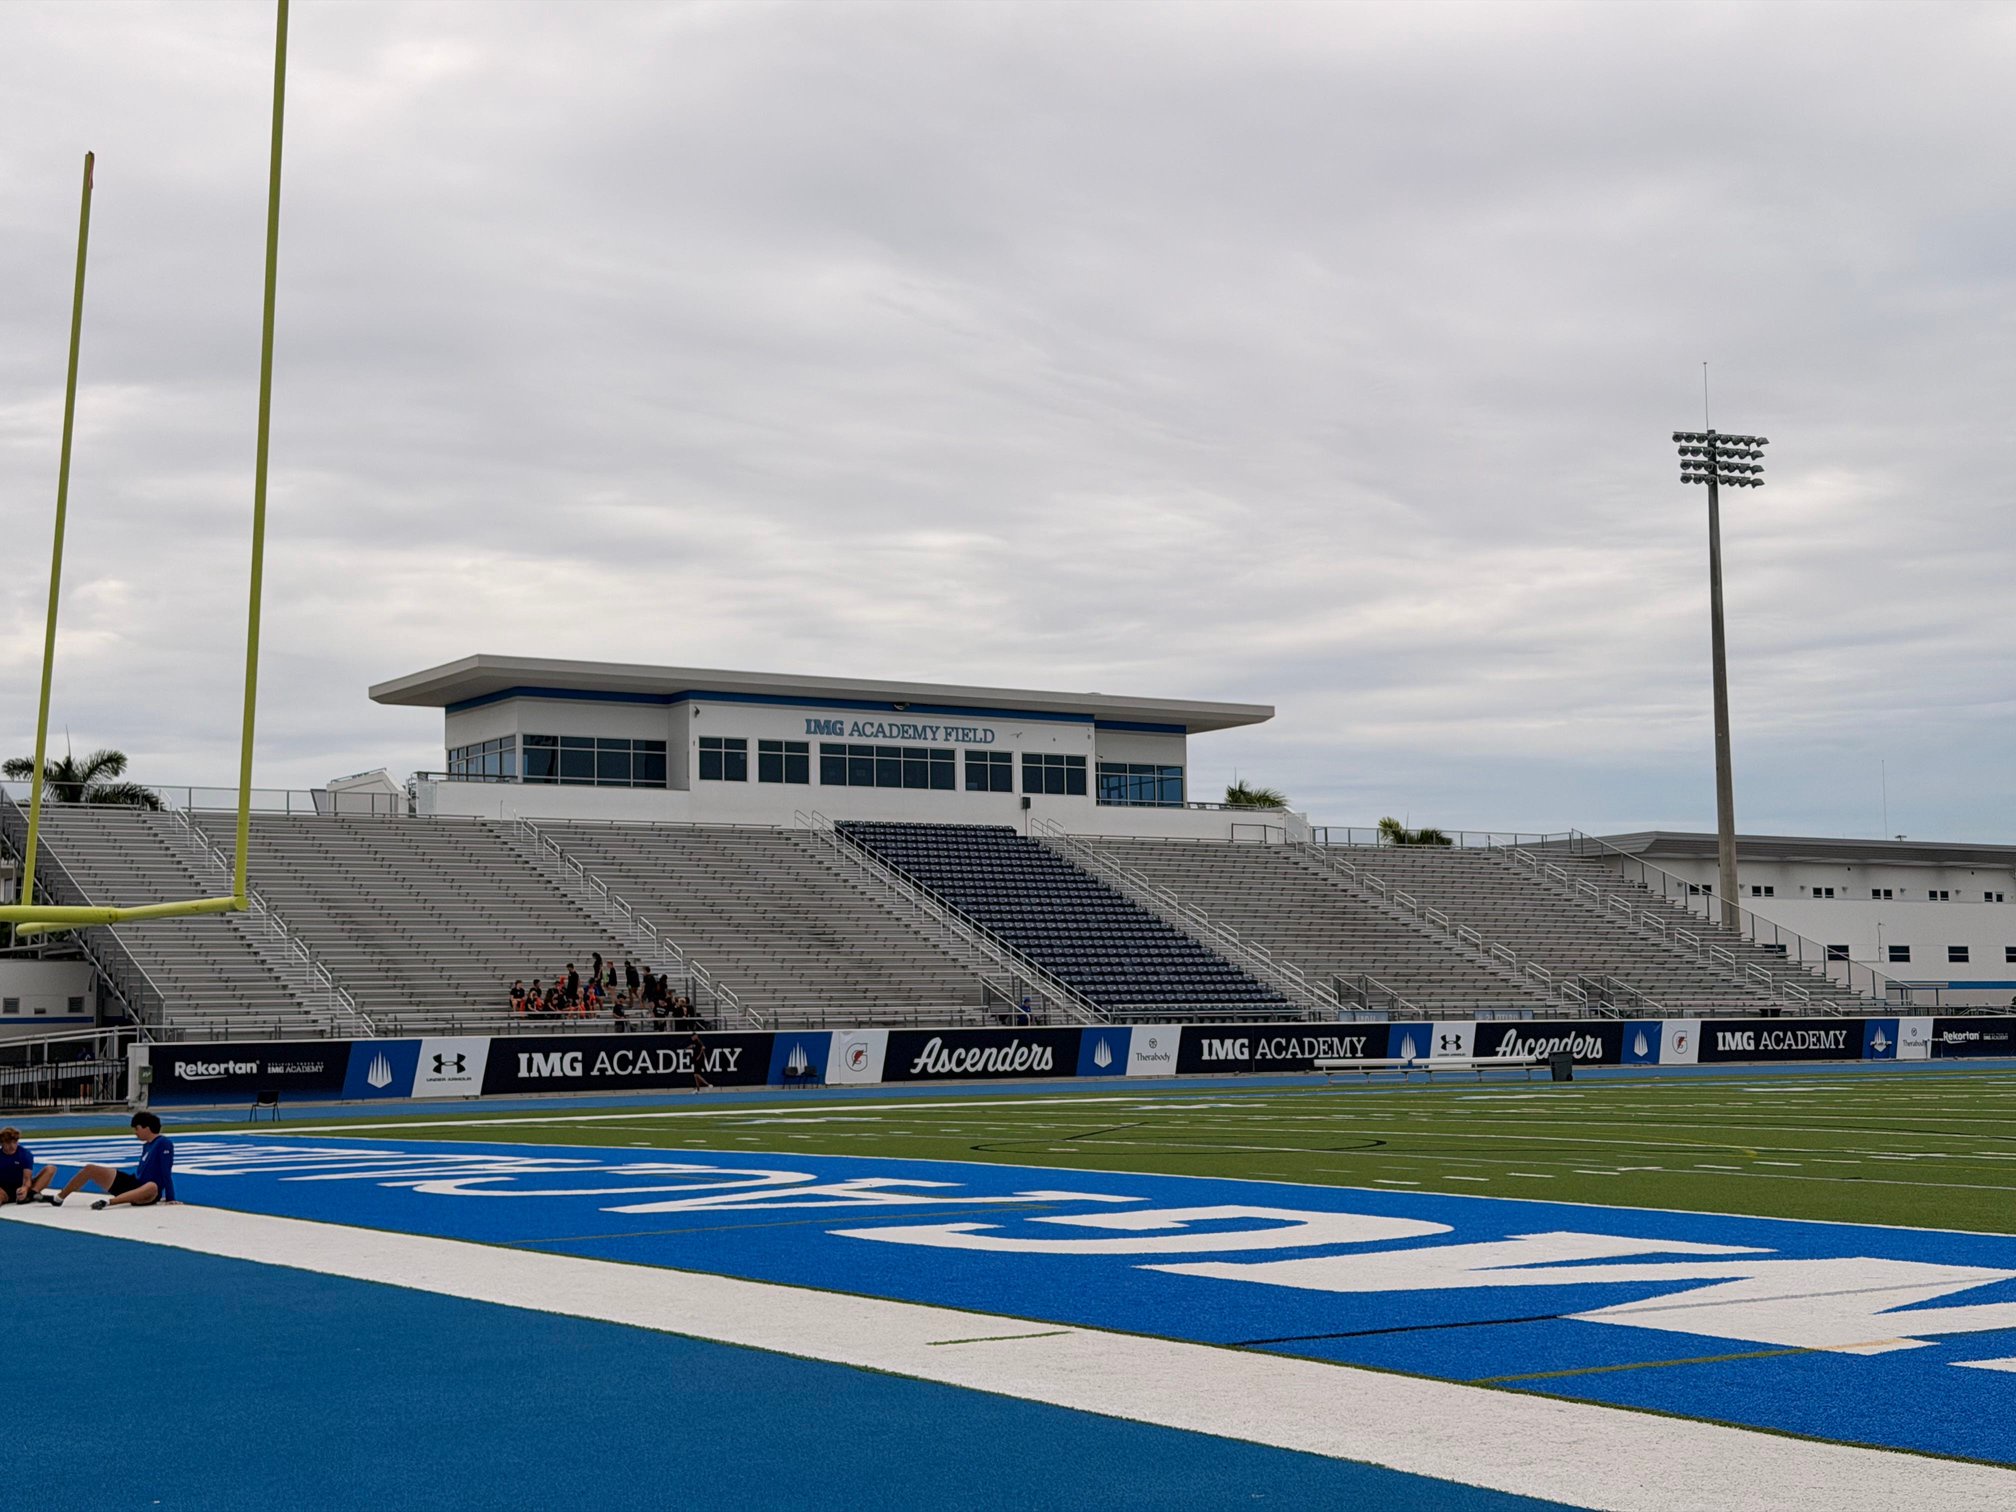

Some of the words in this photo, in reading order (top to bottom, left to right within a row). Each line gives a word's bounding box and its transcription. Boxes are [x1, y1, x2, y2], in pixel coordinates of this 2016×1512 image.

[805, 719, 844, 736] IMG
[849, 721, 941, 741] ACADEMY
[943, 726, 995, 743] FIELD
[1202, 1039, 1249, 1060] IMG
[1254, 1036, 1367, 1059] ACADEMY
[1495, 1028, 1603, 1059] Ascenders
[1716, 1032, 1755, 1051] IMG
[1759, 1031, 1847, 1050] ACADEMY
[1942, 1032, 1980, 1044] Rekortan
[517, 1052, 583, 1078] IMG
[590, 1047, 743, 1076] ACADEMY
[910, 1037, 1053, 1074] Ascenders
[1136, 1051, 1171, 1063] Therabody
[174, 1060, 257, 1081] Rekortan
